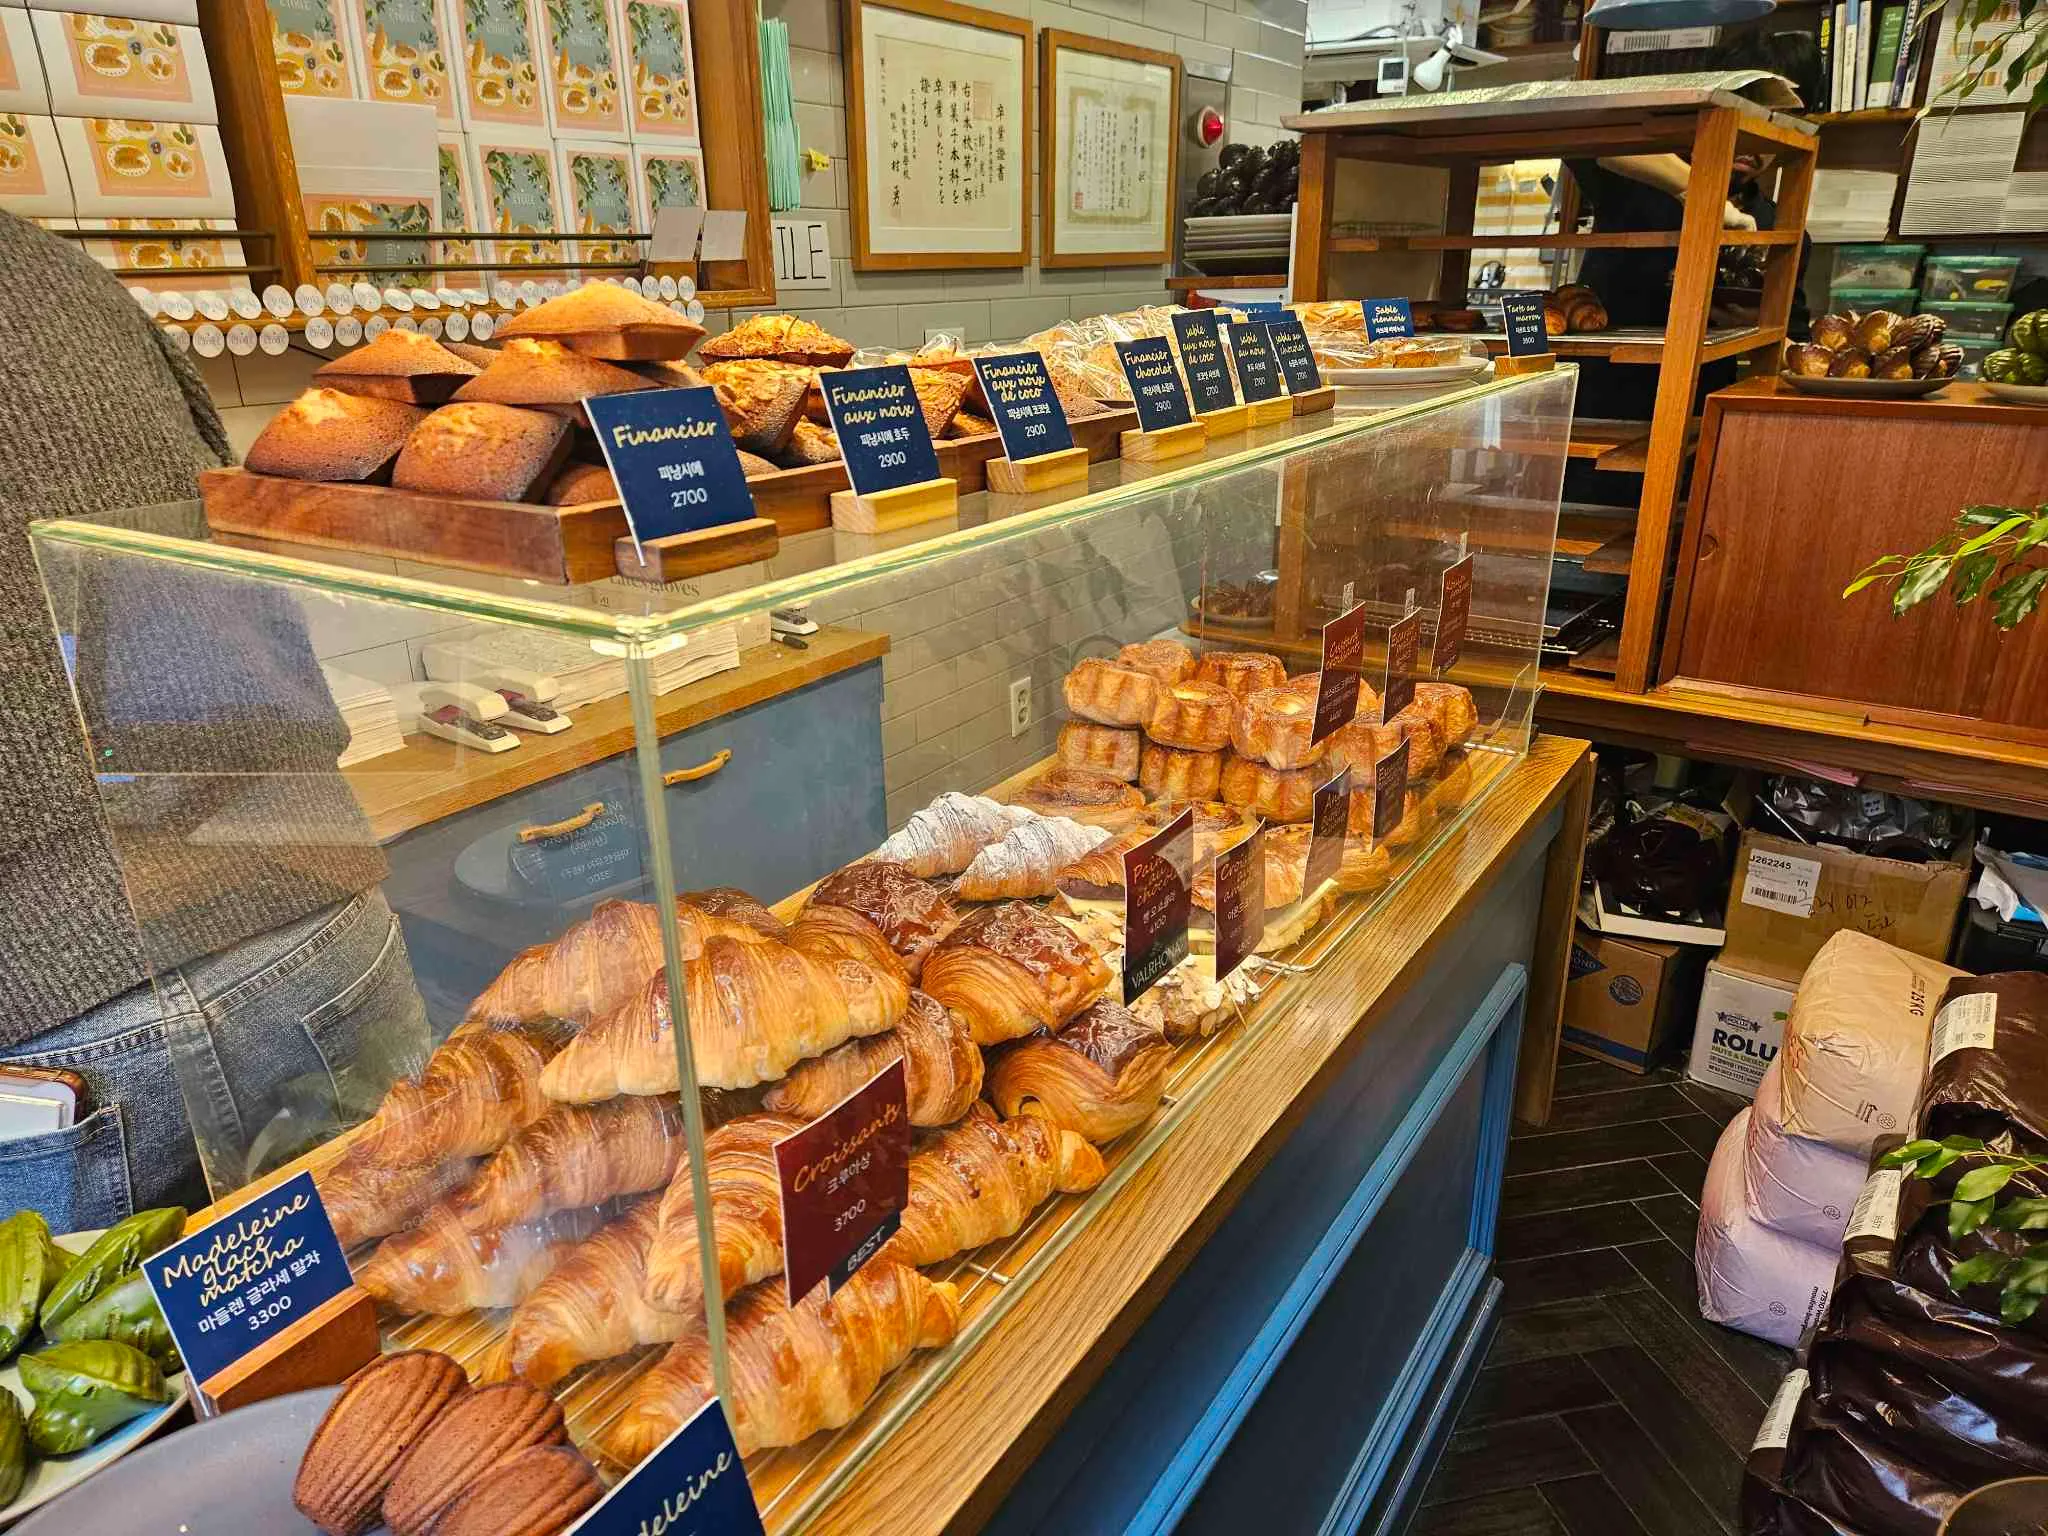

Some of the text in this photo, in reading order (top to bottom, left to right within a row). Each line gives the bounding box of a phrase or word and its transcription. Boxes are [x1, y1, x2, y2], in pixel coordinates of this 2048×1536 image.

[776, 225, 826, 280] ILE
[1124, 348, 1168, 366] Financier
[1188, 352, 1199, 366] de
[981, 361, 1039, 380] Financier
[1135, 362, 1173, 379] chocolat
[831, 381, 907, 407] Financier
[991, 375, 1046, 392] aux noix
[1000, 387, 1043, 403] de coco
[1154, 400, 1172, 412] 2900
[843, 400, 915, 425] aux noix
[612, 417, 718, 448] Financier
[860, 426, 911, 447] 피낭시에 호두
[1024, 423, 1047, 438] 2900
[657, 460, 704, 482] 피낭시에
[878, 451, 907, 469] 2900
[670, 487, 709, 509] 2700
[1796, 879, 1809, 888] 1/1
[1131, 942, 1184, 989] VALRHONA
[833, 1199, 867, 1232] 3700
[163, 1193, 312, 1289] Madeleine
[847, 1225, 886, 1272] BEST
[199, 1236, 305, 1308] matcha
[197, 1250, 321, 1334] 마들렌 글라세 말차
[247, 1295, 293, 1331] 3300
